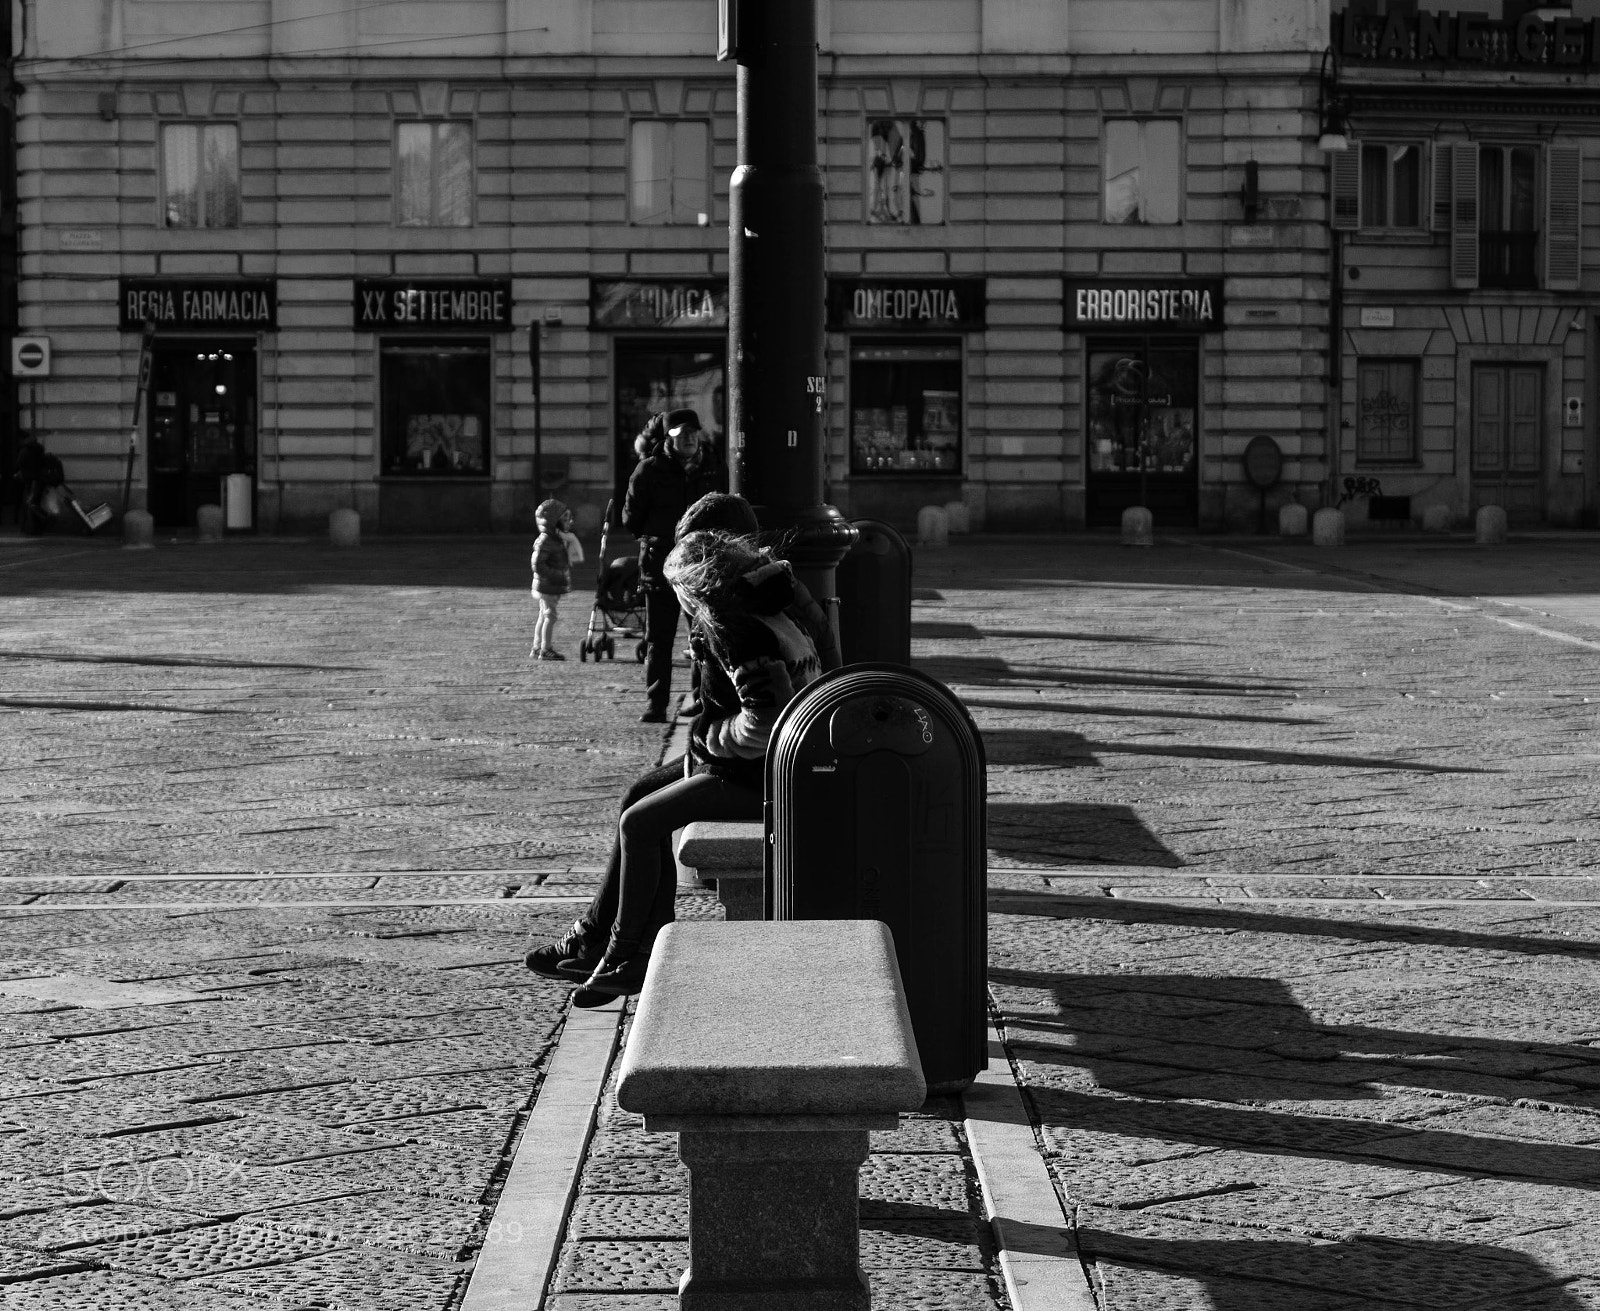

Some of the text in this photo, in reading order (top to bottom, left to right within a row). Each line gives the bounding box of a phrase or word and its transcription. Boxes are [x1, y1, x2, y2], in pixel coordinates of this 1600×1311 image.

[1516, 12, 1600, 63] GE
[127, 289, 270, 321] REGIA FARMACIA
[361, 288, 505, 322] XX SETTEMBRE
[625, 288, 715, 319] IMICA
[852, 287, 960, 320] OMEOPATIA
[1075, 288, 1214, 322] ERBORISTERIA
